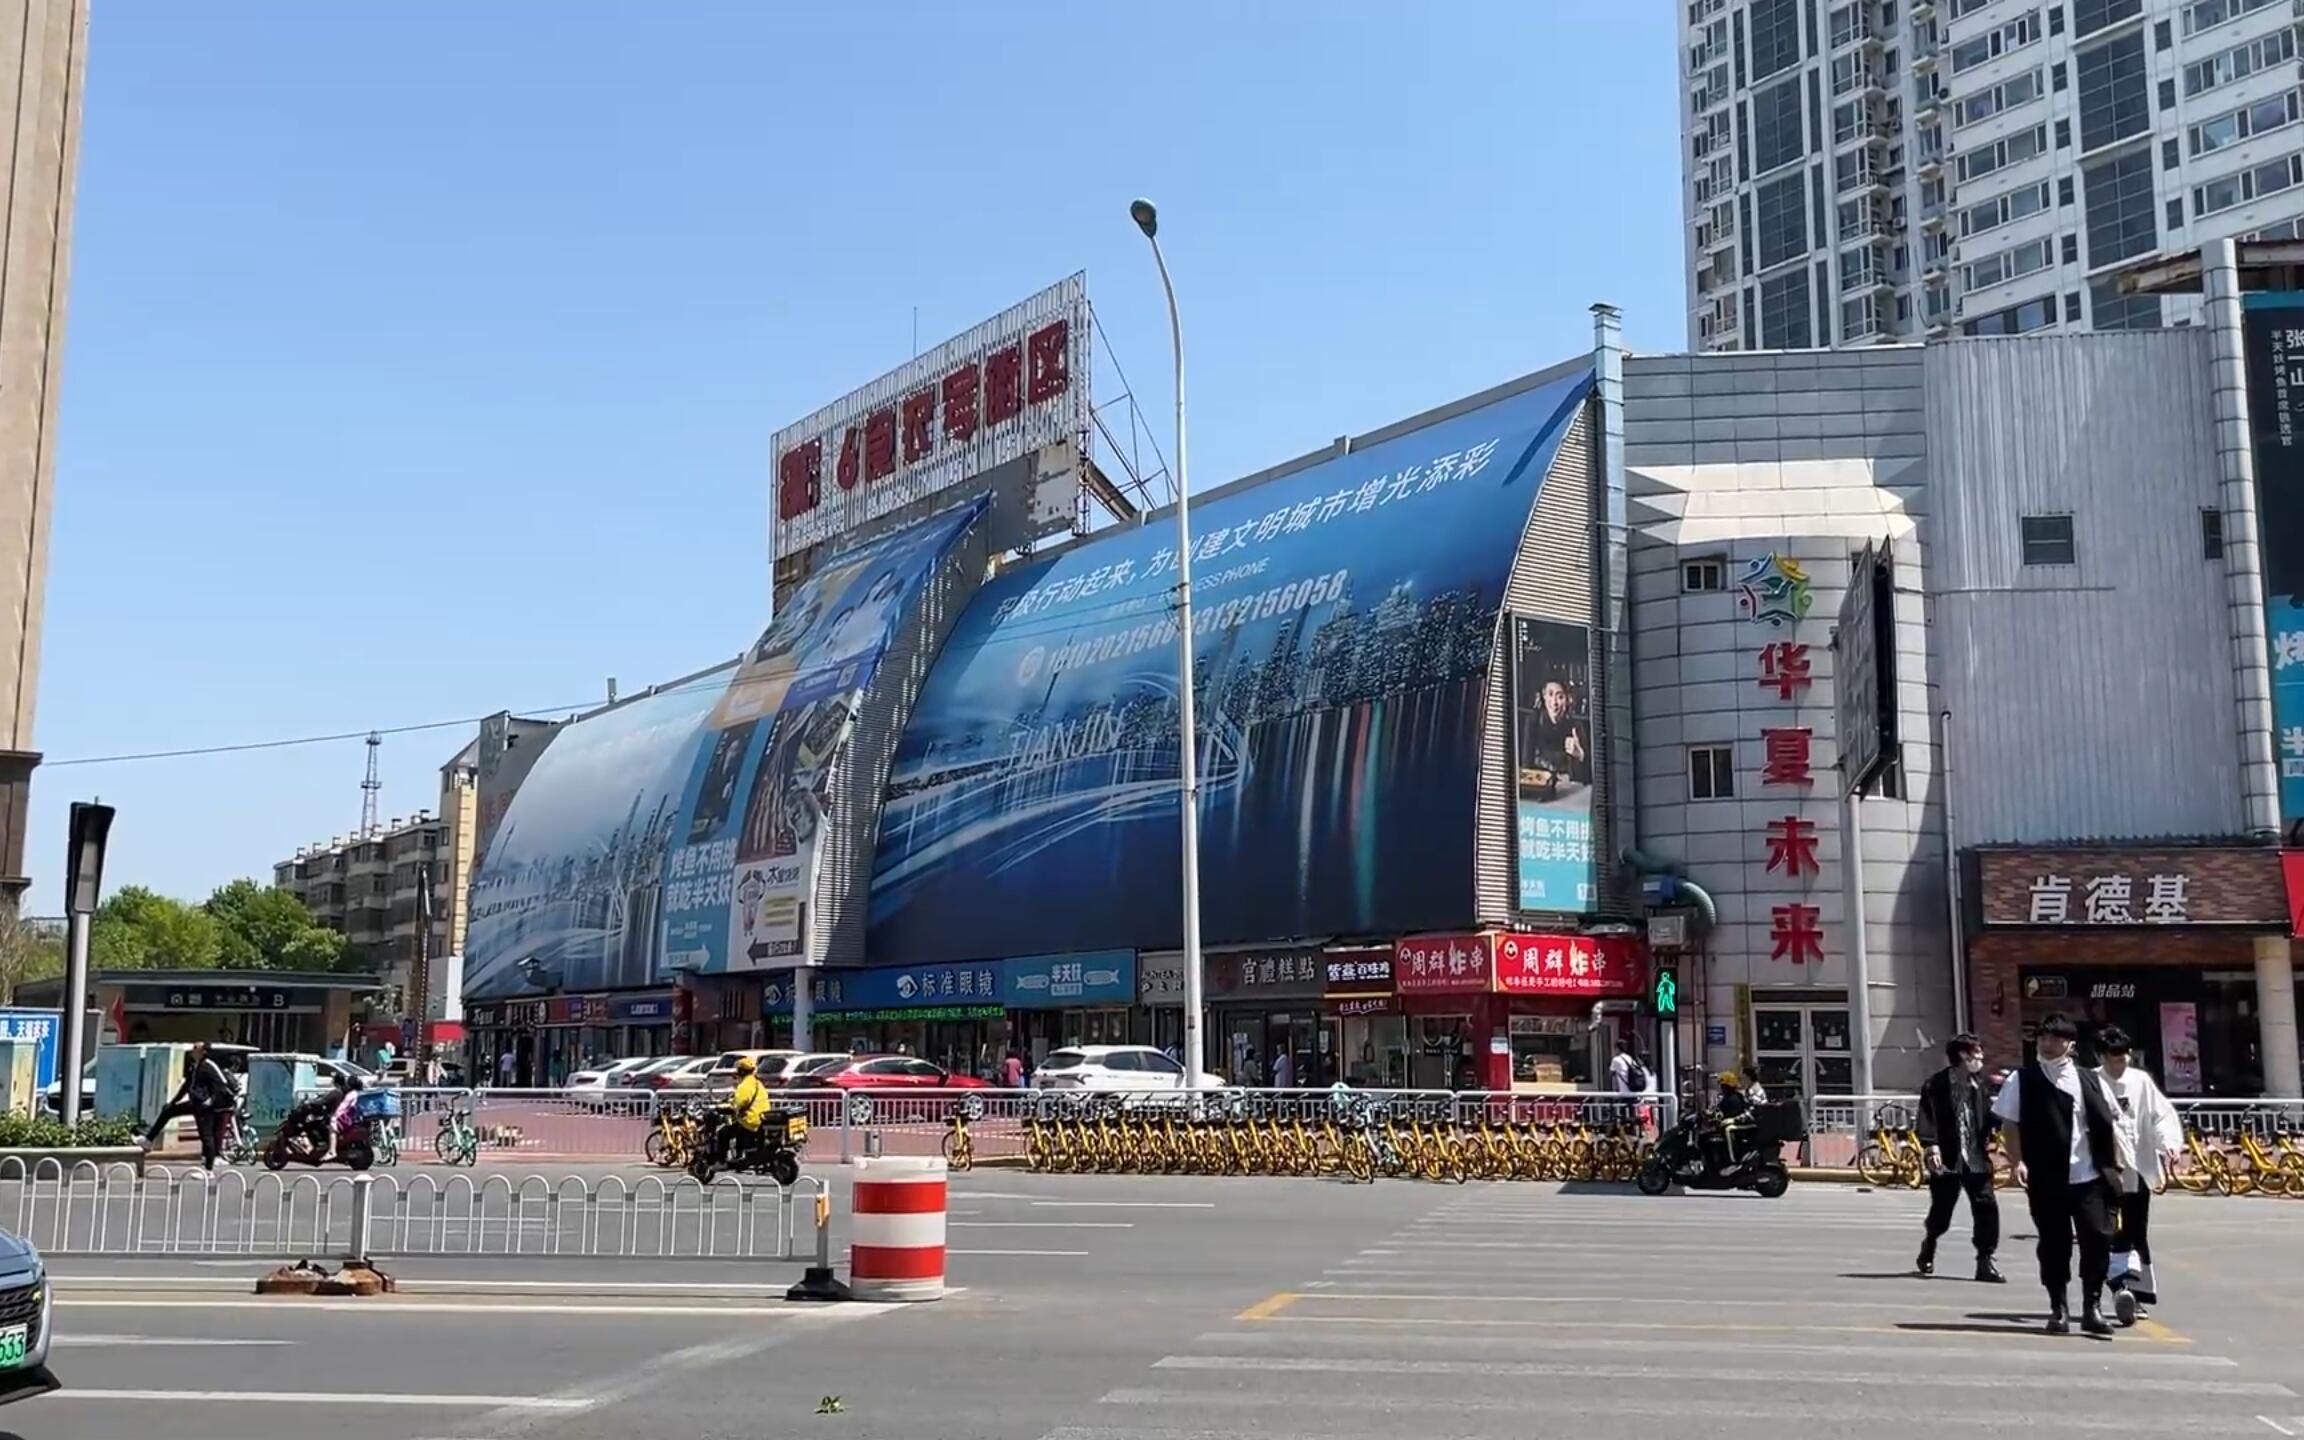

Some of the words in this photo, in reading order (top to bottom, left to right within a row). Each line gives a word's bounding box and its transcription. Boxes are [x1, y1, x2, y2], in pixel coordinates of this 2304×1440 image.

[1758, 642, 1824, 965] 华夏未来
[2028, 874, 2190, 923] 肯德基
[1411, 940, 1484, 976] 周群炸串
[1523, 940, 1608, 976] 周群炸串
[922, 970, 994, 997] 标准眼镜
